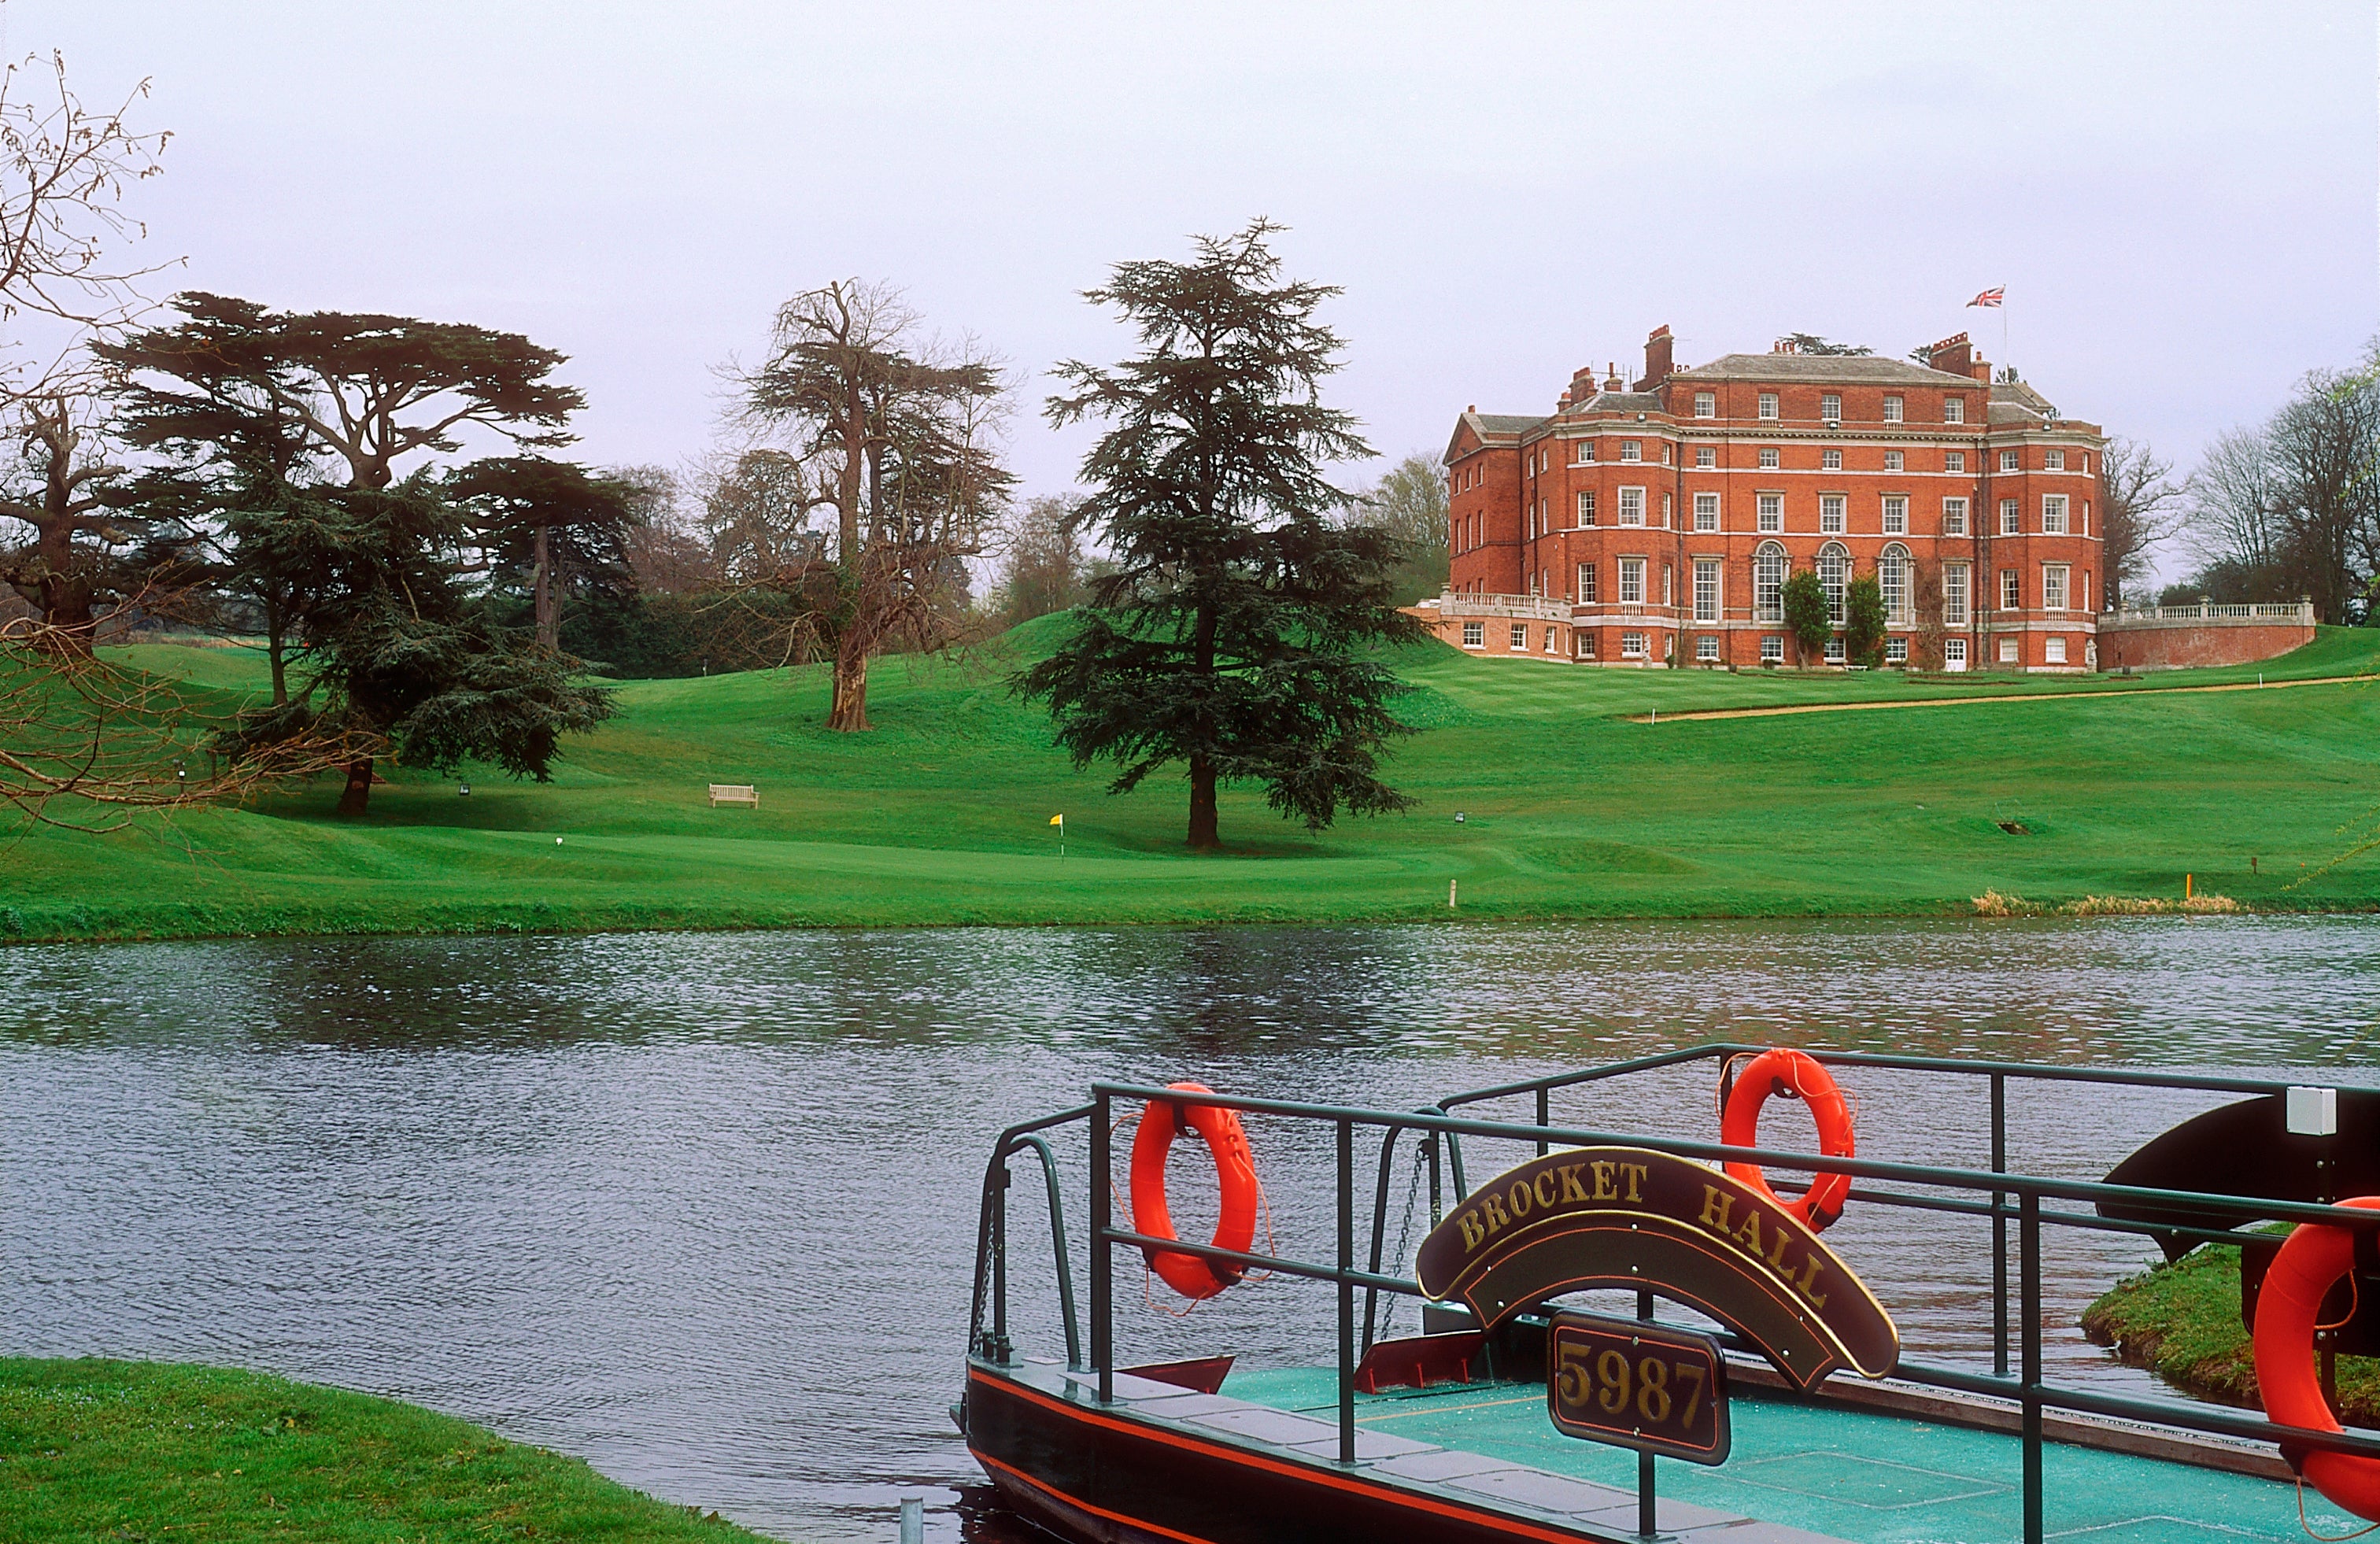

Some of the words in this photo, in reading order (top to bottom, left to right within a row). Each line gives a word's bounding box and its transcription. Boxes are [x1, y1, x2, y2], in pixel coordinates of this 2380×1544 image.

[1456, 1162, 1648, 1253] BROCKET
[1699, 1184, 1828, 1308] HALL
[1559, 1343, 1706, 1428] 5987
